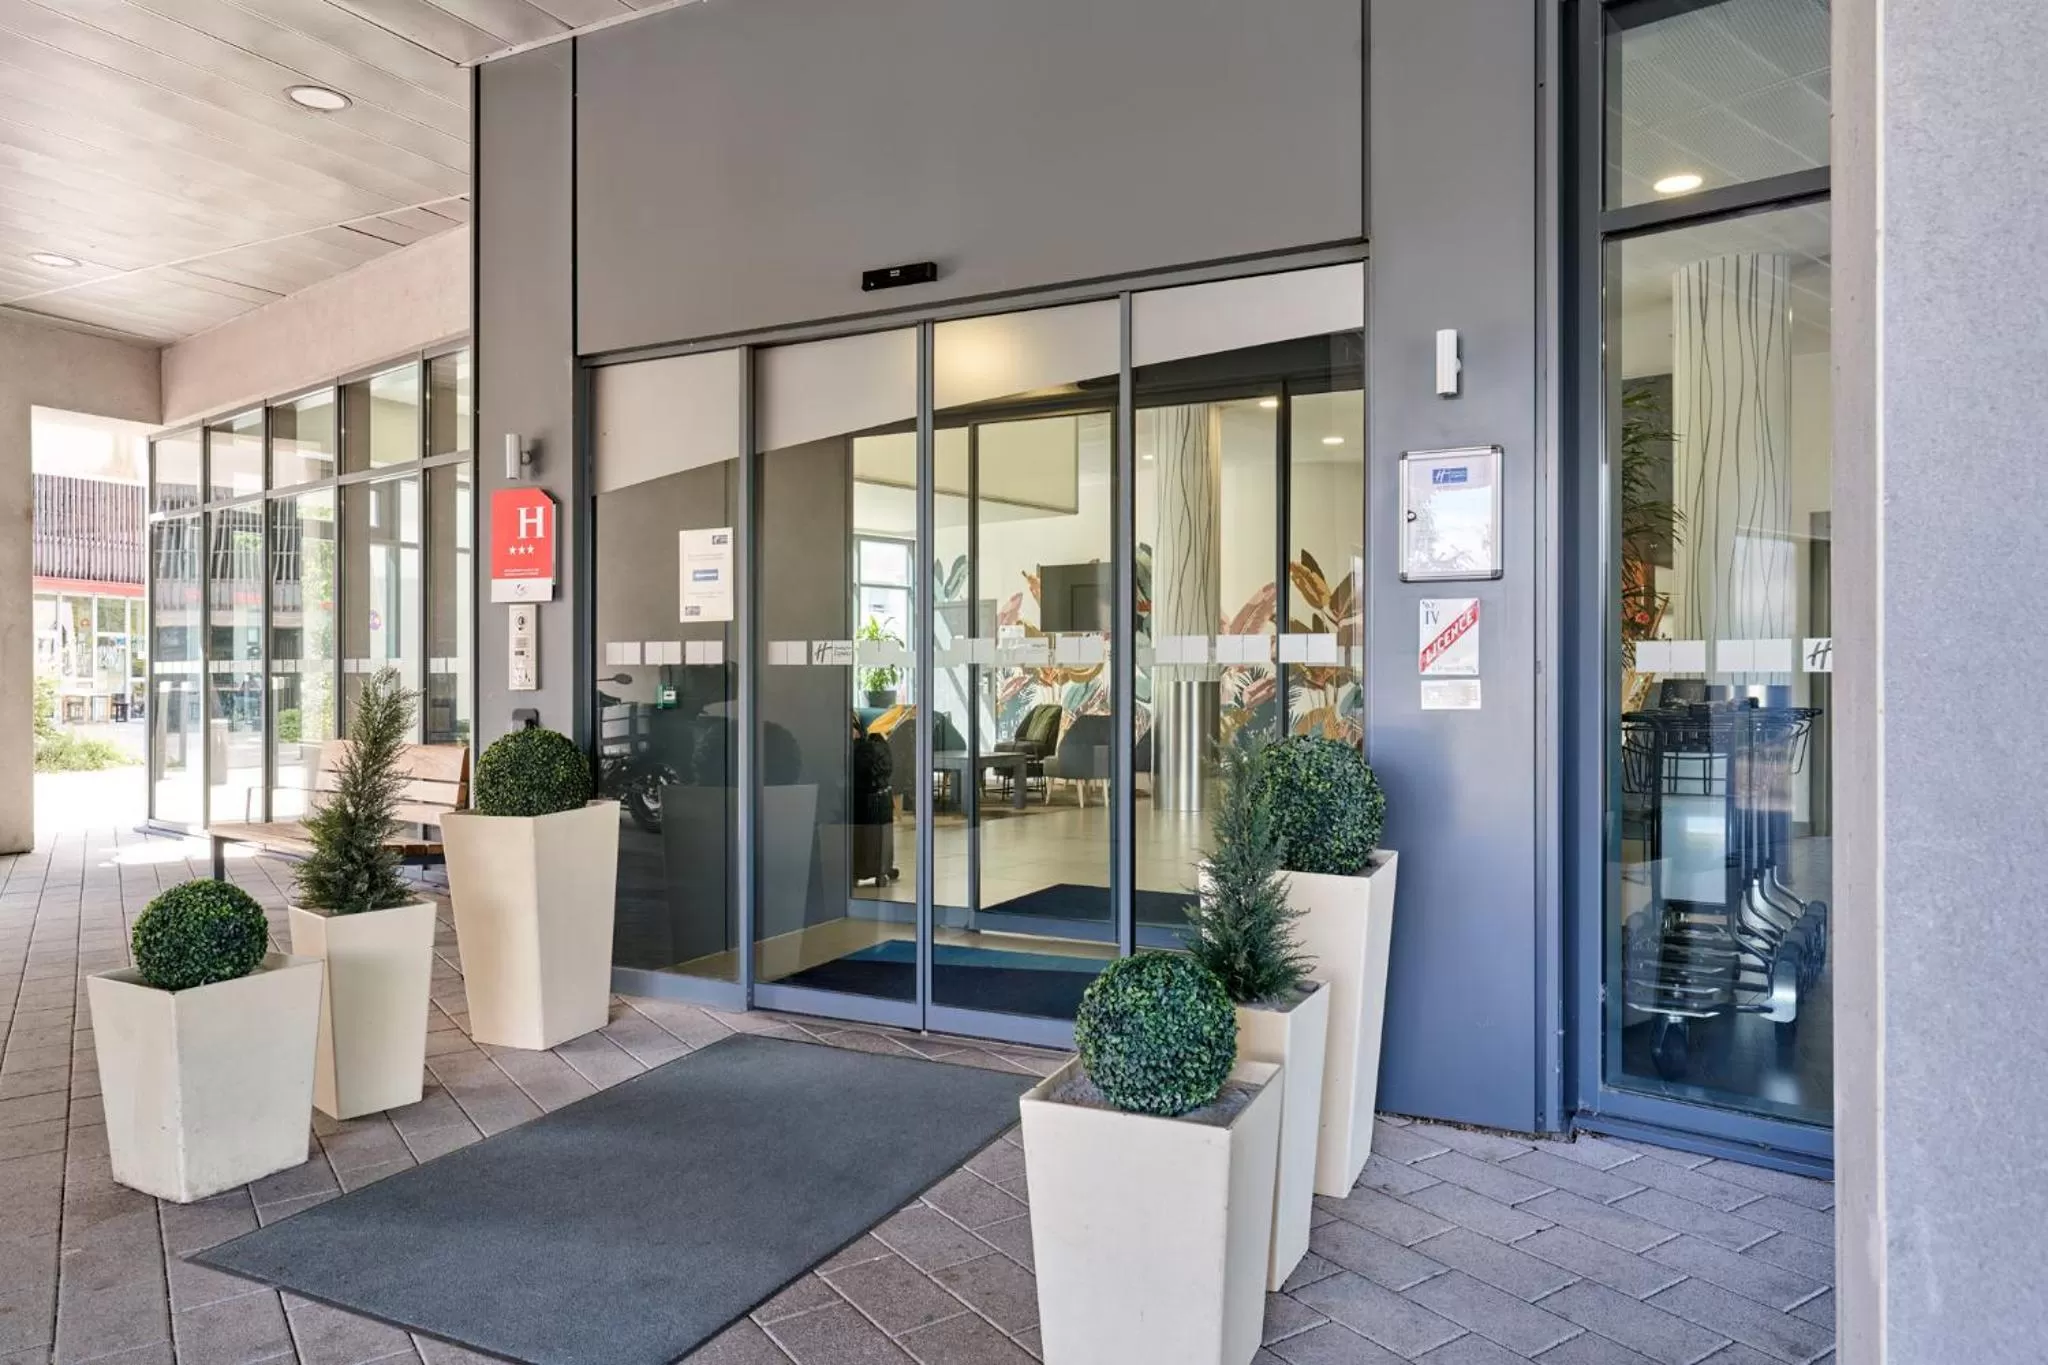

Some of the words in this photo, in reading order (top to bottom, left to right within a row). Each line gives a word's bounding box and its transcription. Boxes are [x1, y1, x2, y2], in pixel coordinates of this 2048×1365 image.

[517, 506, 545, 539] H
[1425, 611, 1440, 625] IV
[1426, 608, 1476, 665] LICENCE
